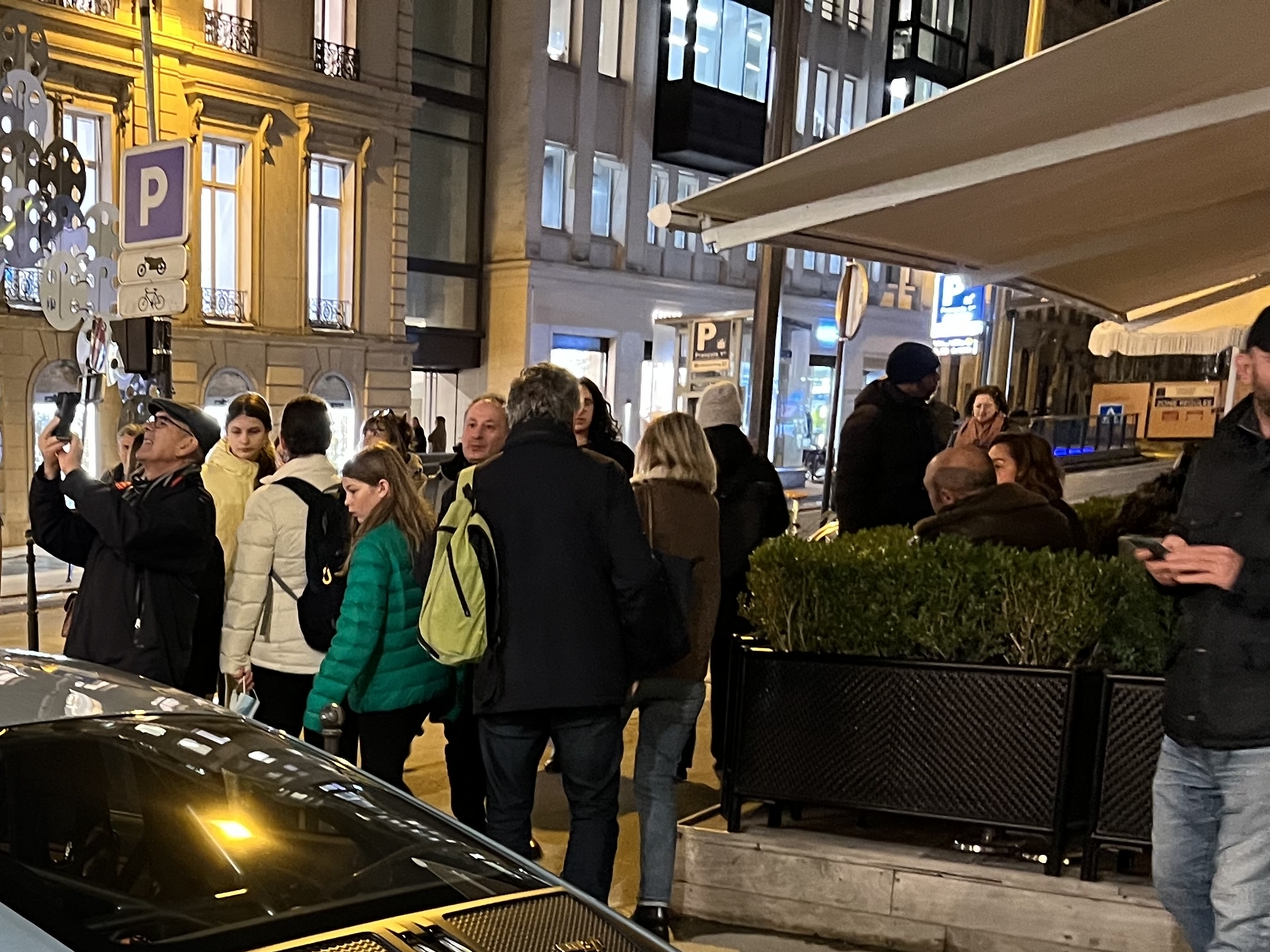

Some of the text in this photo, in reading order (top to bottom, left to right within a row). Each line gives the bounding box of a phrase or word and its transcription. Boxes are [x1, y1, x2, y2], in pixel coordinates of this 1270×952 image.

[140, 166, 168, 227] P
[942, 275, 965, 306] P
[697, 323, 717, 351] P
